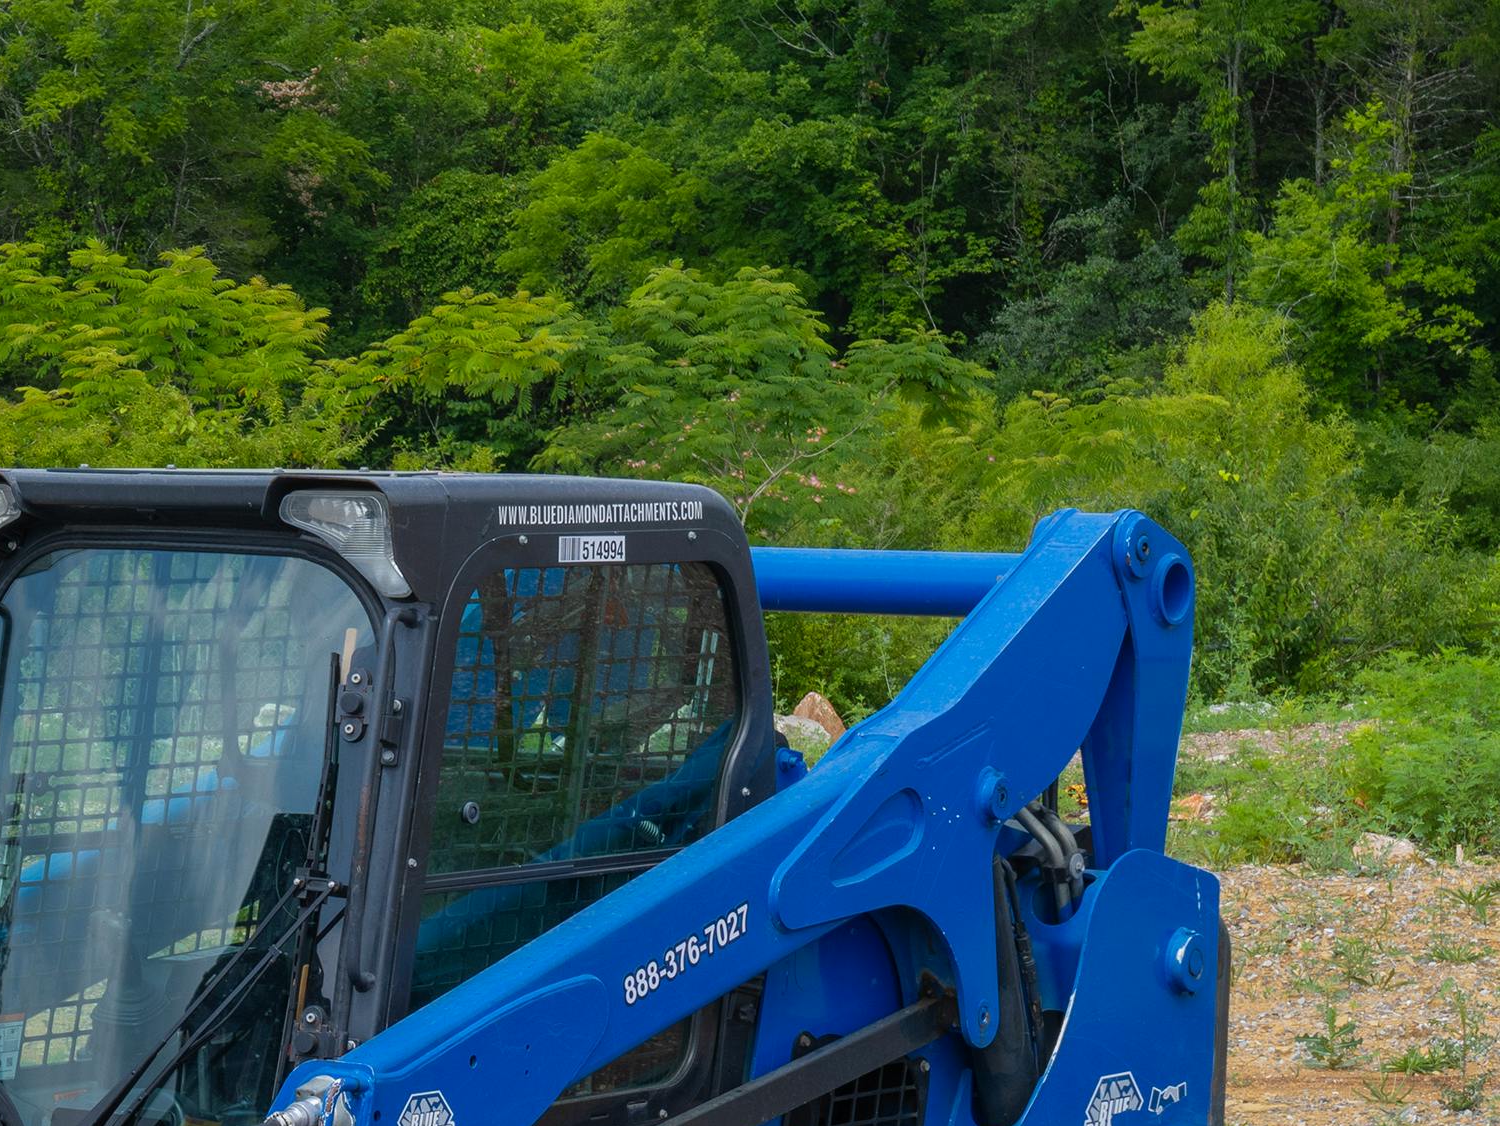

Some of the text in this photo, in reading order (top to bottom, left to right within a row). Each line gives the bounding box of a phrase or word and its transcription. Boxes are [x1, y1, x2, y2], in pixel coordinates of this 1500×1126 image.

[498, 501, 703, 525] WWW.BLUEDIAMONDATTACHMENTS.COM
[582, 541, 623, 559] 514994
[624, 903, 749, 1005] 888-376-7027
